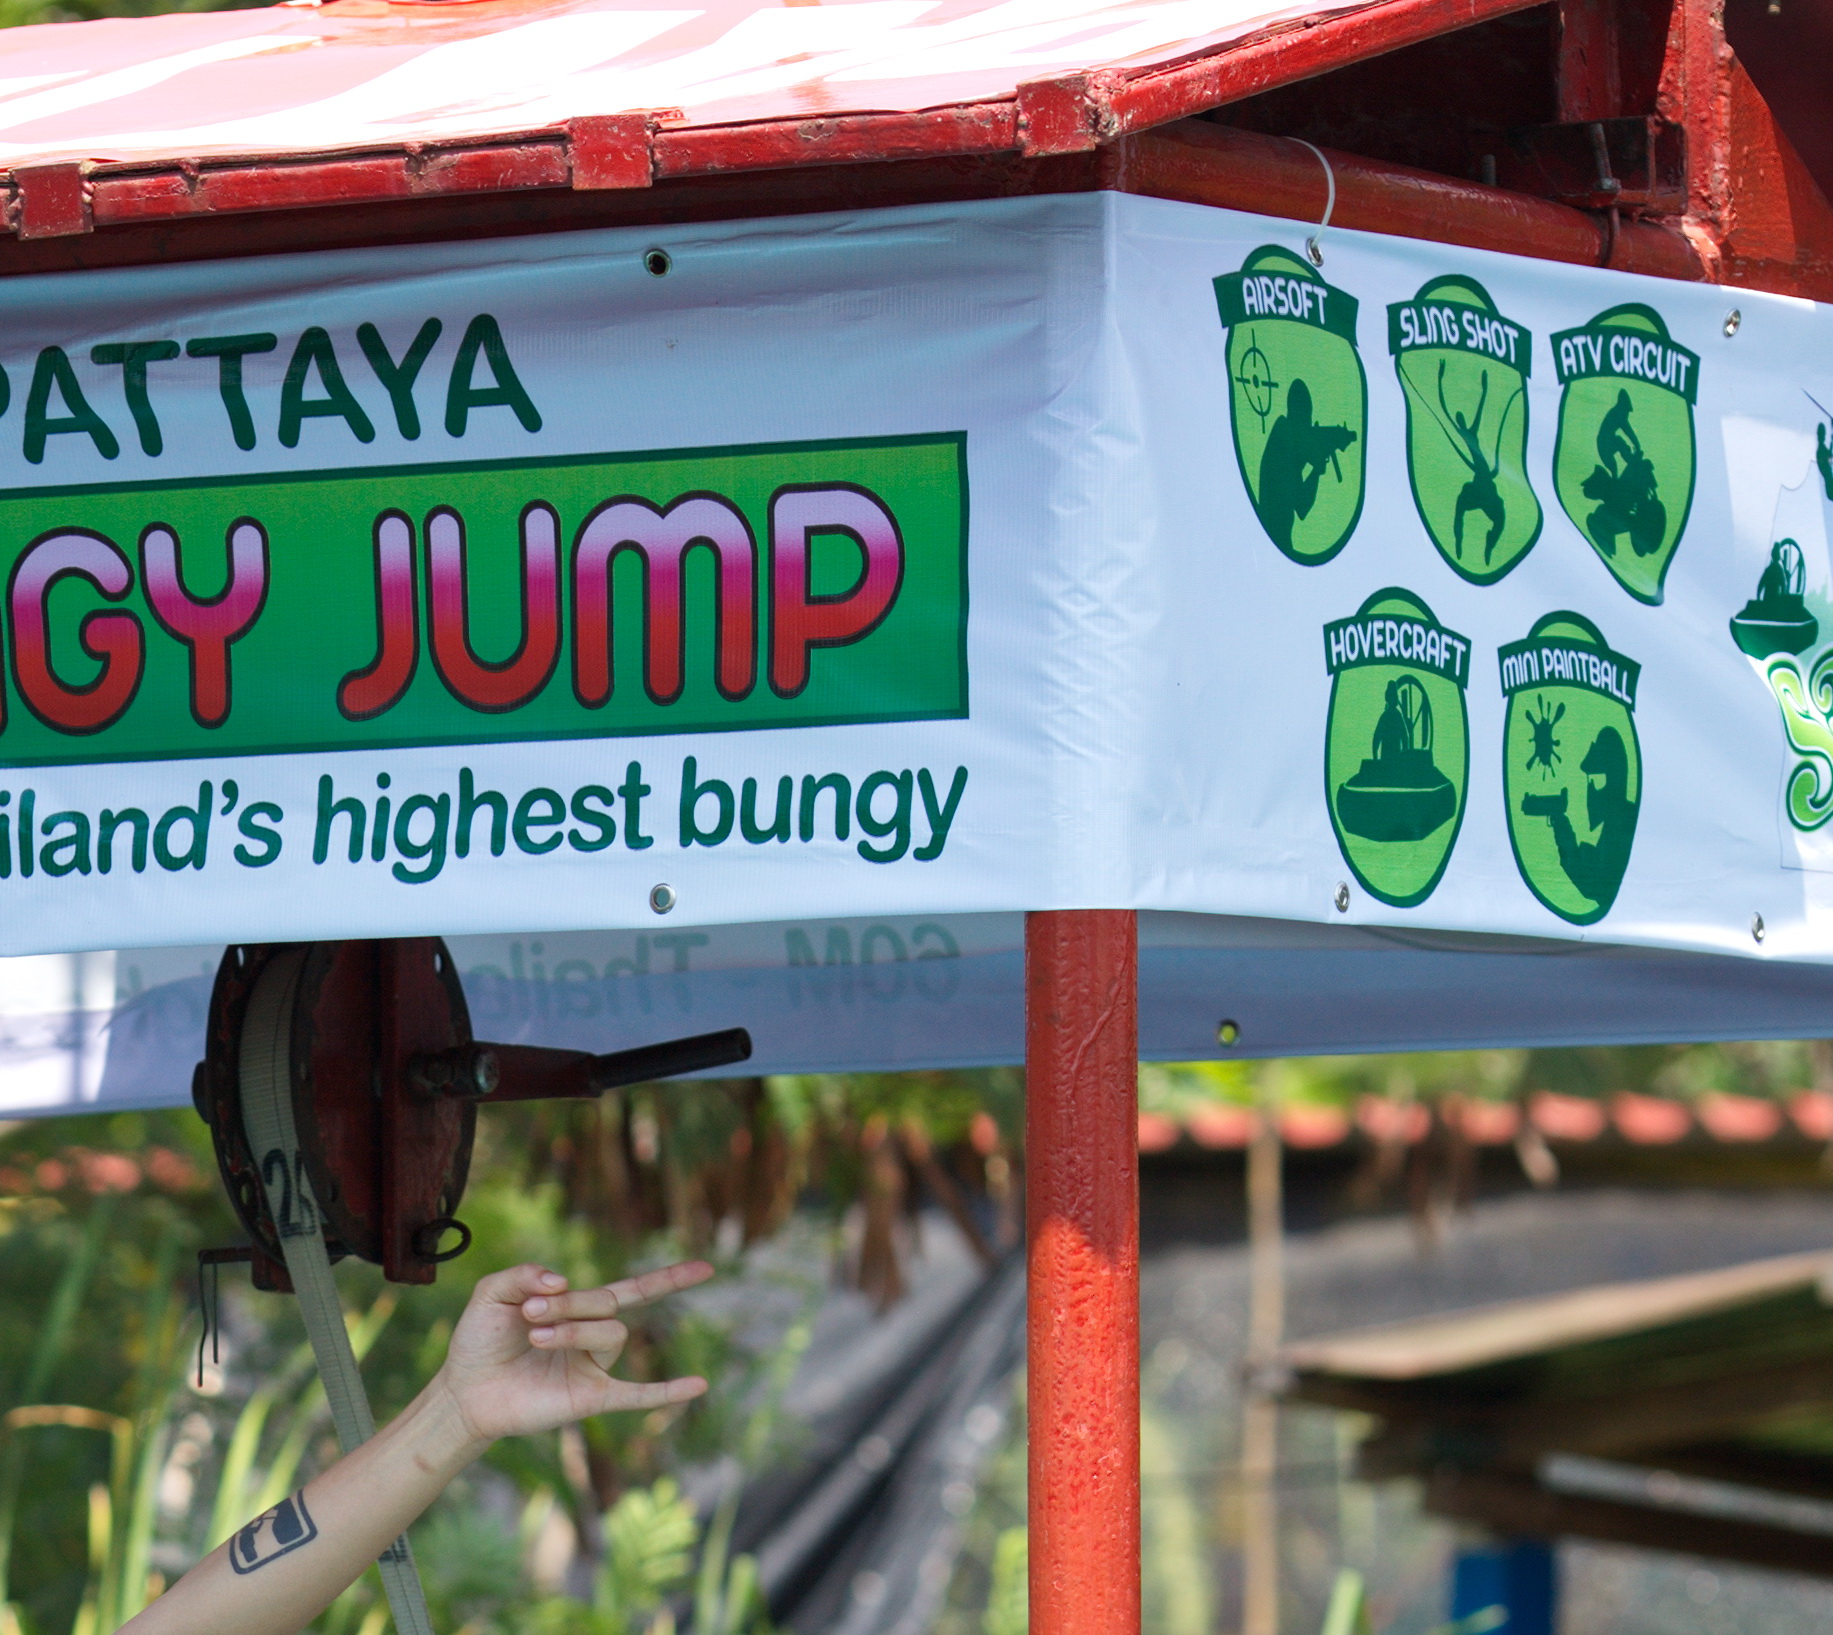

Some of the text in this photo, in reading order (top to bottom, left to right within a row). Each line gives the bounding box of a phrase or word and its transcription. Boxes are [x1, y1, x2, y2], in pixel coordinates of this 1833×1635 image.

[1242, 276, 1328, 323] AIRSOFT
[1399, 306, 1519, 363] SLING SHOT
[1560, 335, 1691, 392] ATV CIRCUIT
[338, 484, 905, 722] JUMP
[1329, 620, 1467, 677] HOVERCRAFT
[1502, 649, 1634, 704] MINI PAINTBALL
[311, 759, 655, 887] highest
[678, 754, 970, 867] bungy
